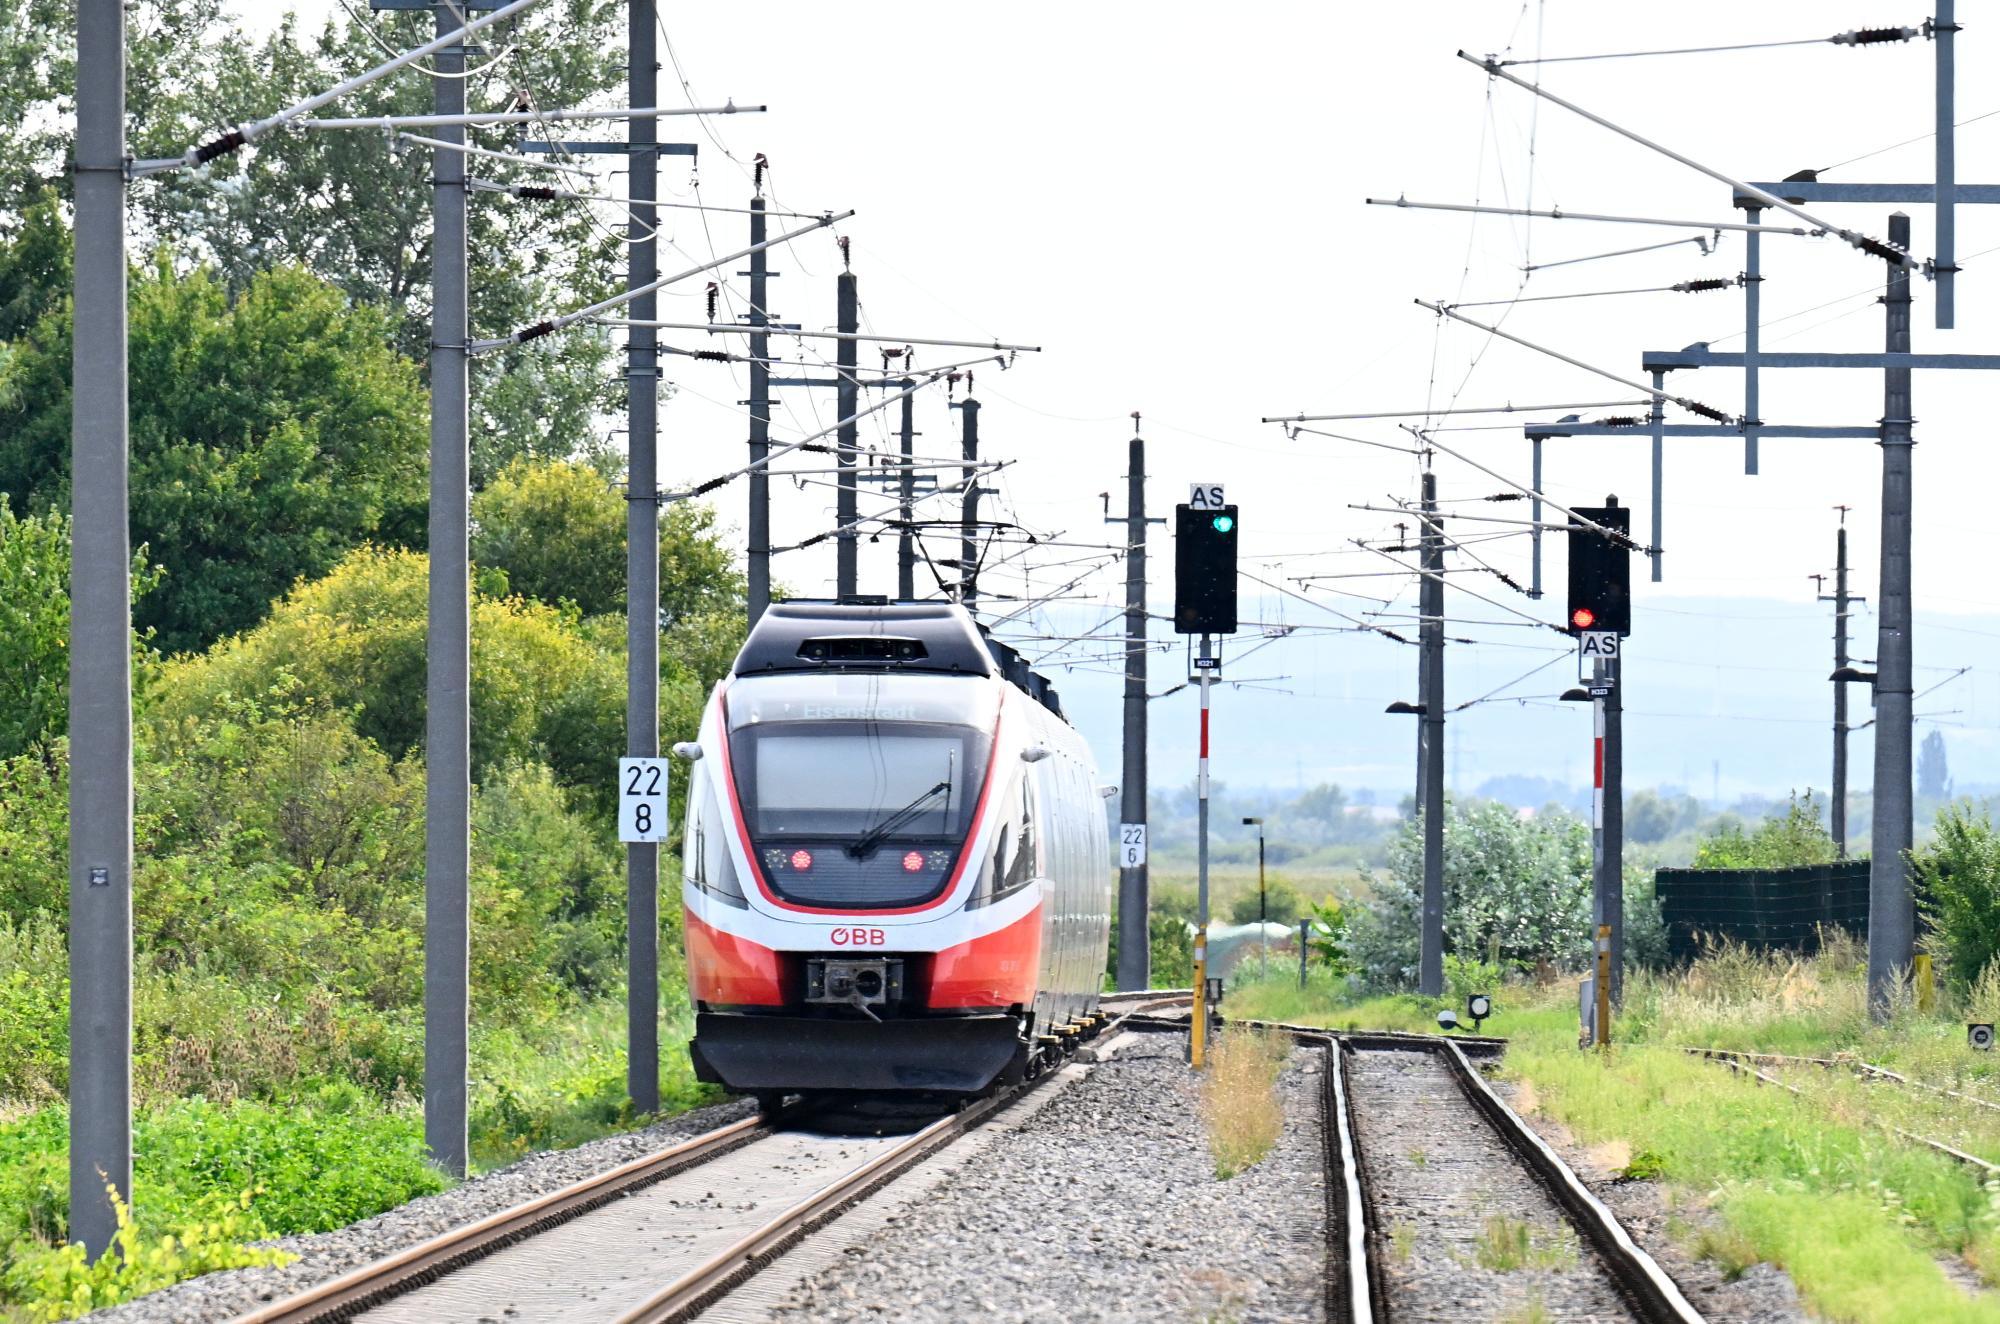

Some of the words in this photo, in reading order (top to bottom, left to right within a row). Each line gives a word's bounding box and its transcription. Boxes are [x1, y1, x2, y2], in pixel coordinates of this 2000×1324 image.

[1191, 487, 1224, 506] AS
[1583, 636, 1616, 655] AS
[804, 703, 916, 719] Eisenstadt
[626, 766, 661, 796] 22
[635, 803, 652, 834] 8
[1123, 828, 1142, 844] 22
[1128, 847, 1137, 864] 6
